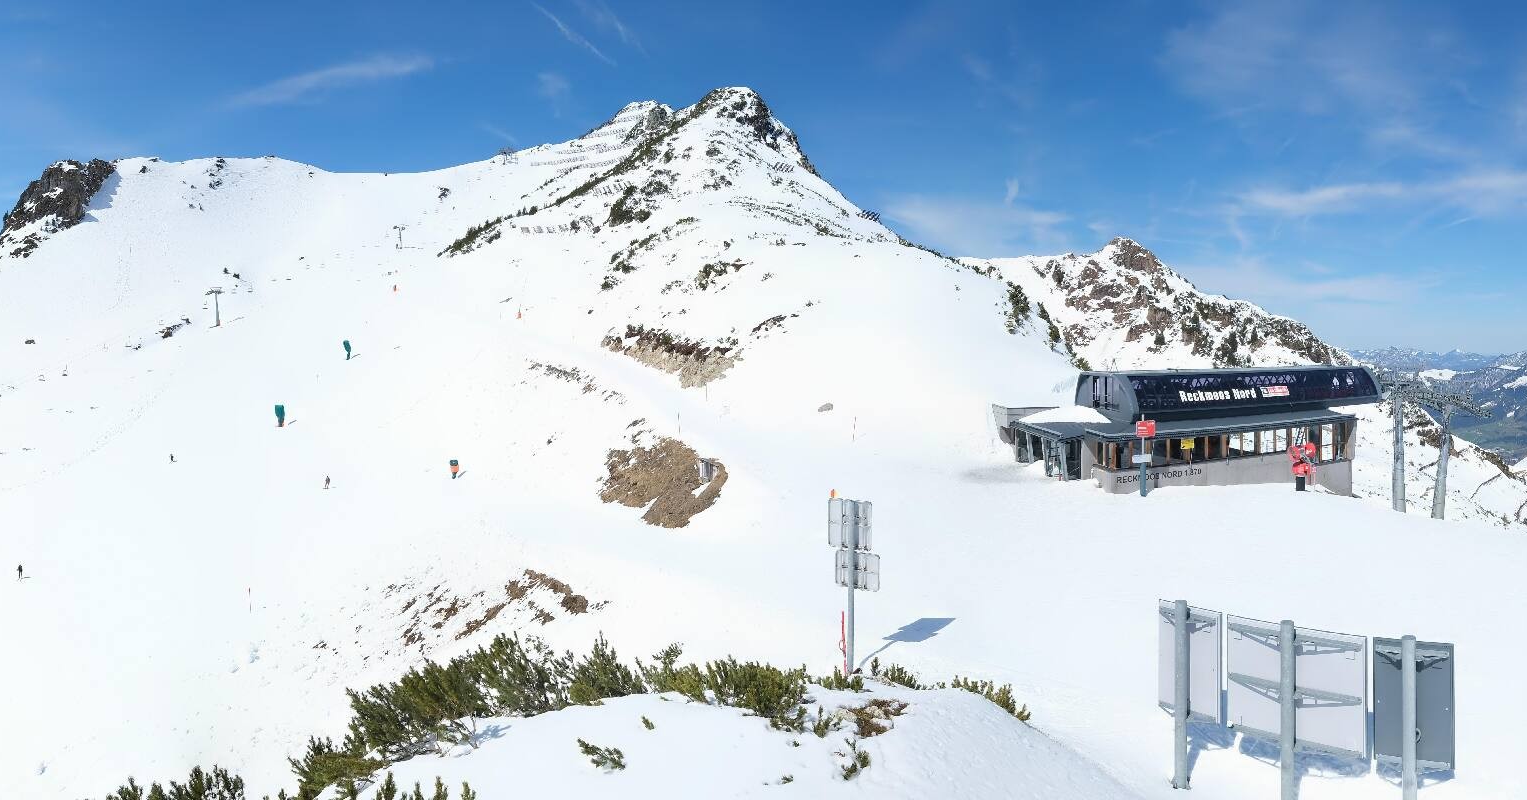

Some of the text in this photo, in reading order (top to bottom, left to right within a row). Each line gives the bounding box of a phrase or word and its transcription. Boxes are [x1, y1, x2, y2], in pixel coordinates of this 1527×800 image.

[1178, 390, 1231, 402] Reckmoos
[1231, 387, 1257, 399] Nord
[1116, 472, 1160, 484] RECKOOS
[1162, 470, 1183, 479] NORD
